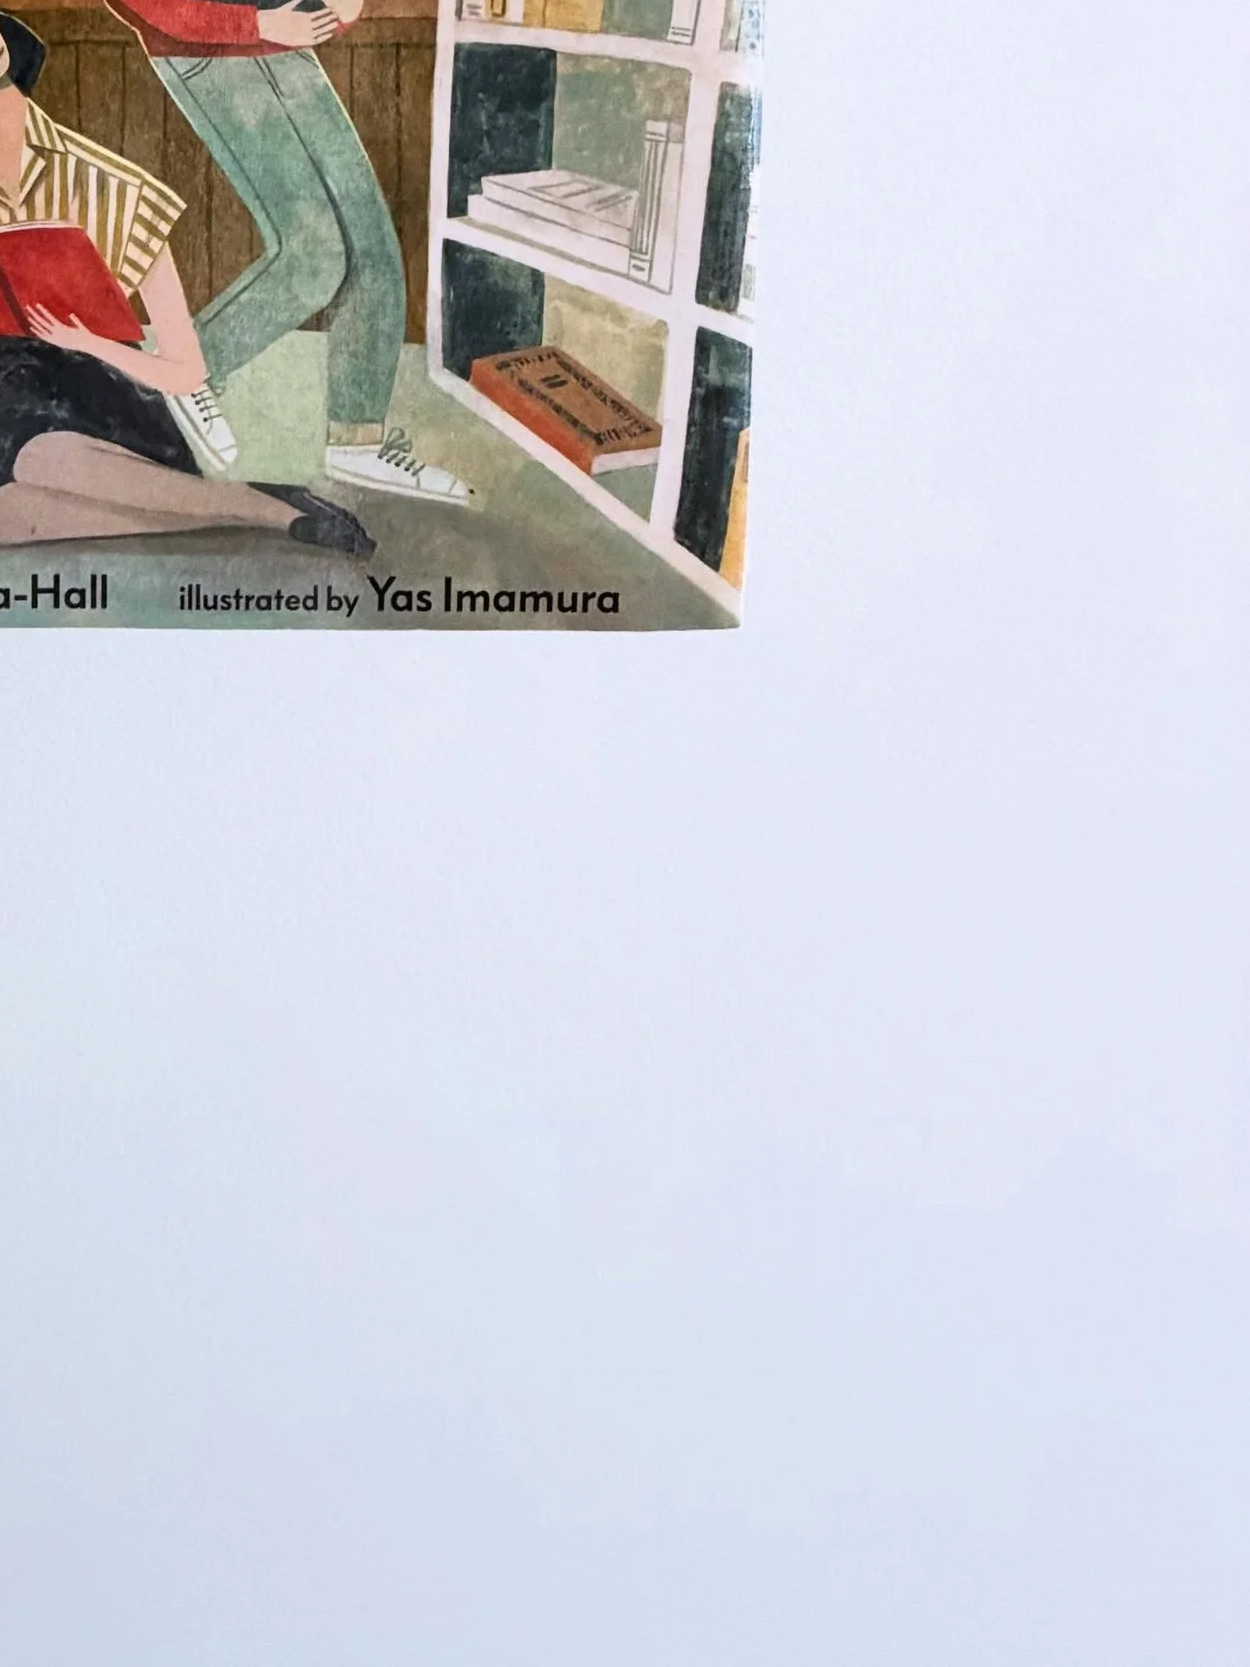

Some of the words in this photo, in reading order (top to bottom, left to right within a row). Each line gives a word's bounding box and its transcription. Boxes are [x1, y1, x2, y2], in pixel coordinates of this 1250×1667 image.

[179, 583, 319, 612] illustrated
[326, 585, 360, 618] by
[366, 574, 433, 613] Yas
[443, 576, 620, 614] Imamura
